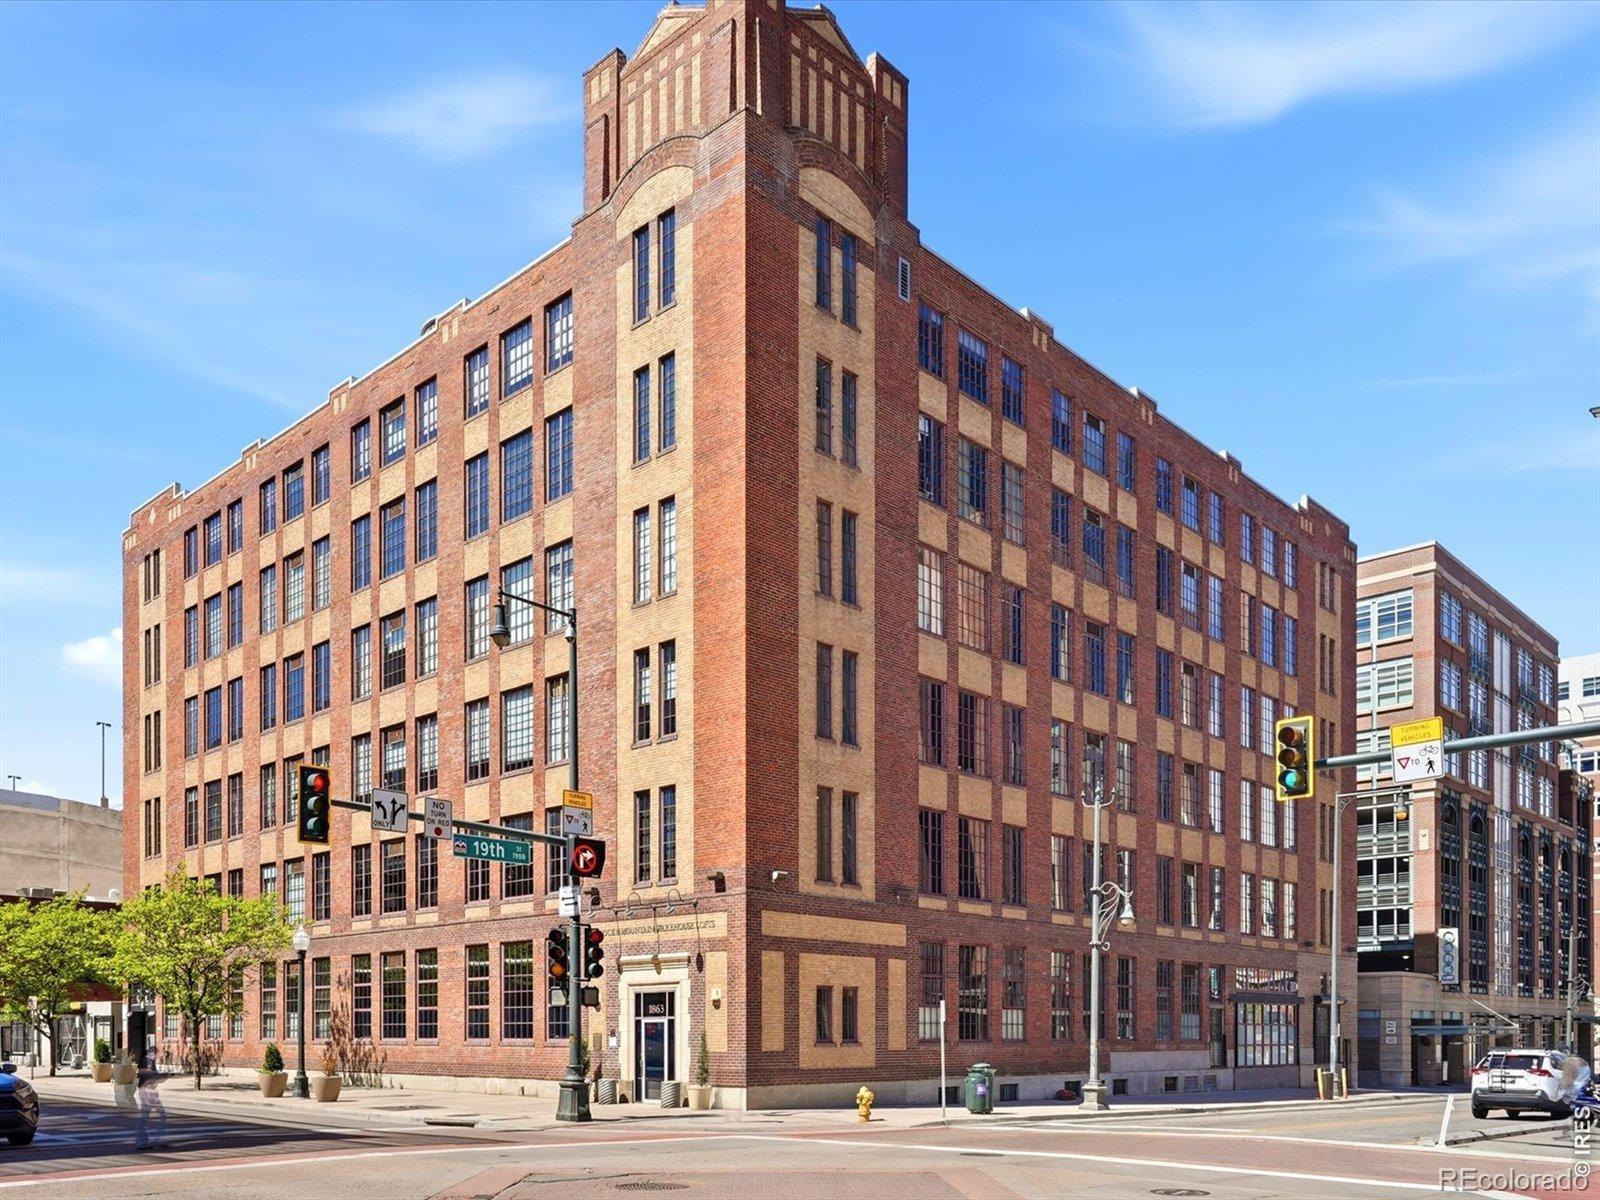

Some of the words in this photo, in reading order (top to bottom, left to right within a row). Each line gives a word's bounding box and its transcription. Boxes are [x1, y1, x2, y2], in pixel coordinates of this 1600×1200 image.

[432, 801, 445, 810] NO
[431, 810, 446, 818] TURN
[373, 819, 390, 828] ONLY
[438, 819, 449, 827] RED
[473, 841, 505, 858] 19th
[649, 1004, 665, 1014] 1863
